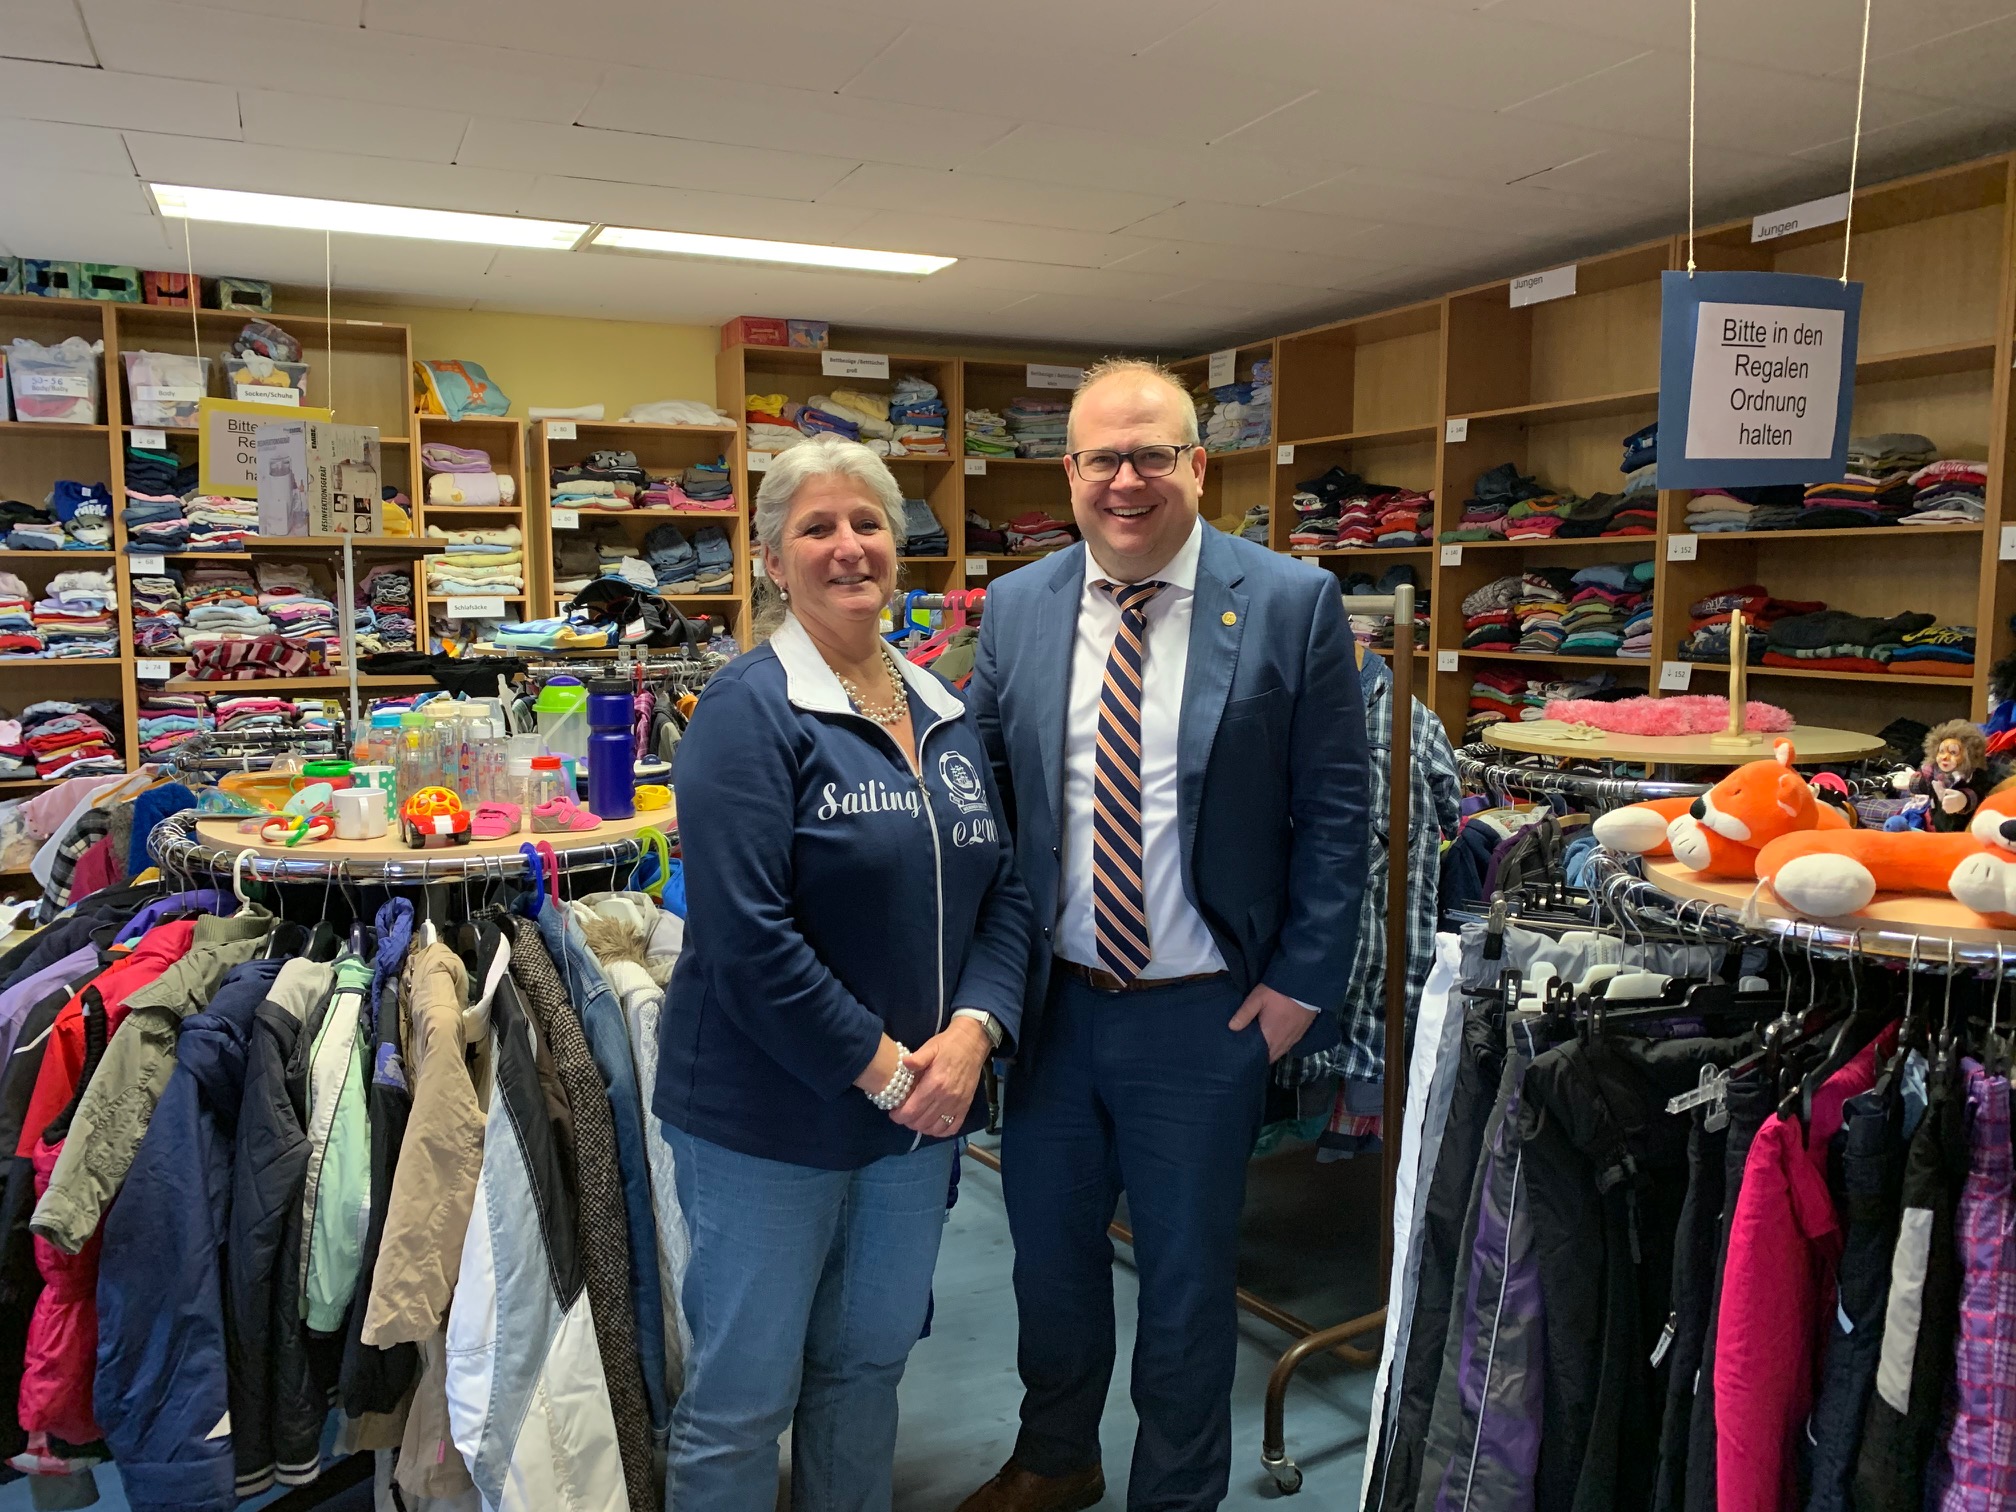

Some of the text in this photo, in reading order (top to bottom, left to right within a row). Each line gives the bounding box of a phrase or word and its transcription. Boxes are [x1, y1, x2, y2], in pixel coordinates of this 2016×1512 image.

[1757, 219, 1799, 238] Jungen
[1513, 276, 1544, 290] Jungen
[1722, 318, 1823, 346] Bitte in den
[1734, 353, 1809, 384] Regalen
[158, 389, 176, 397] Body
[244, 389, 293, 399] Socken/Schuhe
[1730, 387, 1807, 419] Ordnung
[228, 418, 259, 432] Bitte
[1738, 422, 1793, 446] halten
[319, 465, 328, 532] DESINFEKTIONSGERÄT
[1680, 546, 1692, 554] 152
[1674, 670, 1686, 678] 152
[817, 779, 922, 821] Sailing
